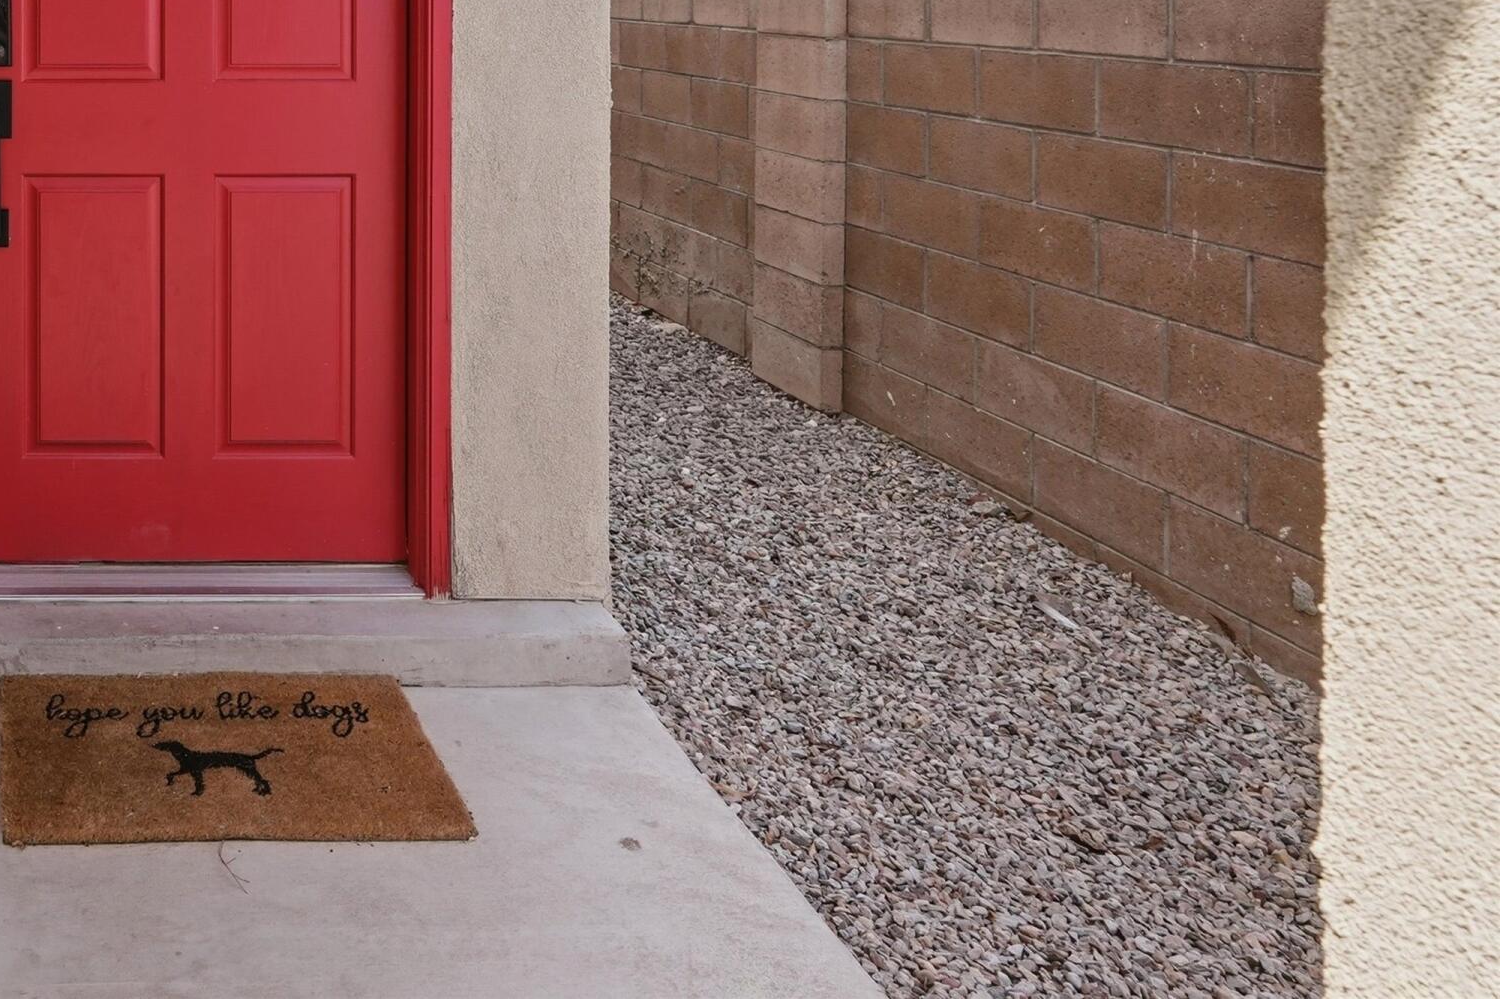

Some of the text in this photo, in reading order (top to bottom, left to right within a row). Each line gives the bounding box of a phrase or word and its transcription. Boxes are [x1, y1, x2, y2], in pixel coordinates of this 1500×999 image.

[45, 691, 370, 738] hope you like dogs
